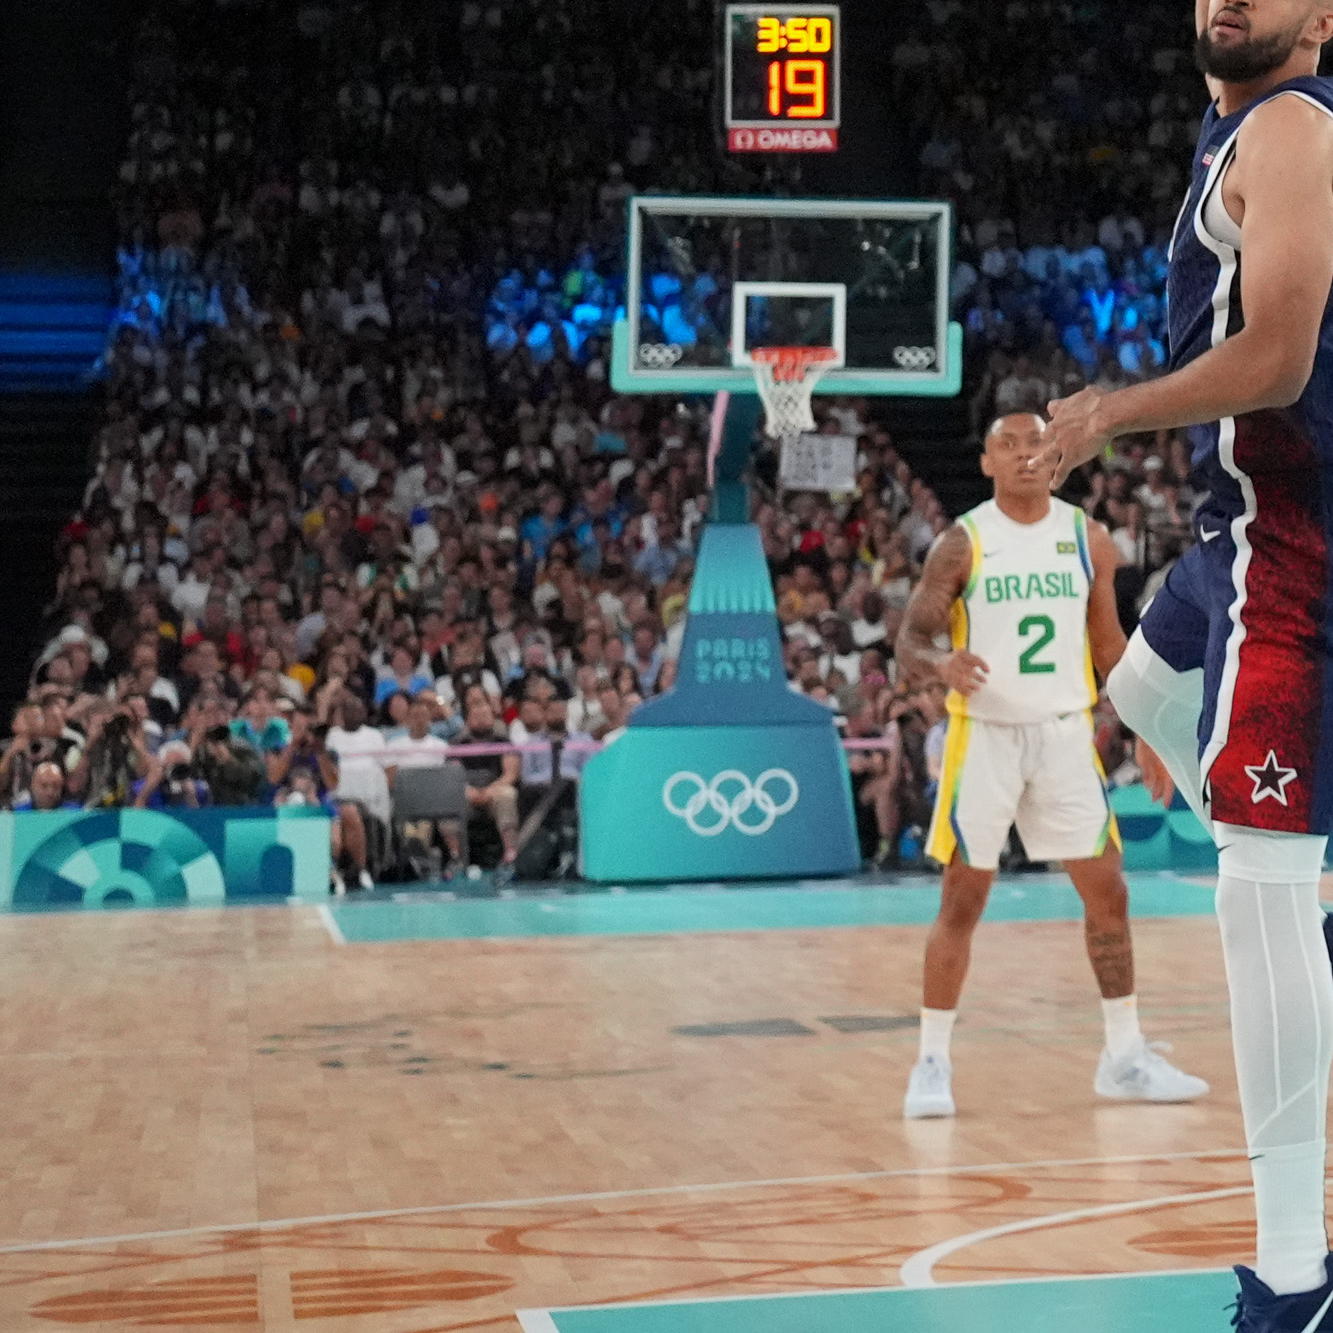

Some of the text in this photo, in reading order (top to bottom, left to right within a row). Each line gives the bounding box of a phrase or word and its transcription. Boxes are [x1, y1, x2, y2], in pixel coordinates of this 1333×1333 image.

[757, 17, 832, 54] 3:50
[768, 59, 826, 119] 19
[757, 129, 834, 150] OMEGA
[984, 572, 1080, 604] BRASIL
[694, 637, 771, 661] PARIS
[1017, 614, 1057, 674] 2
